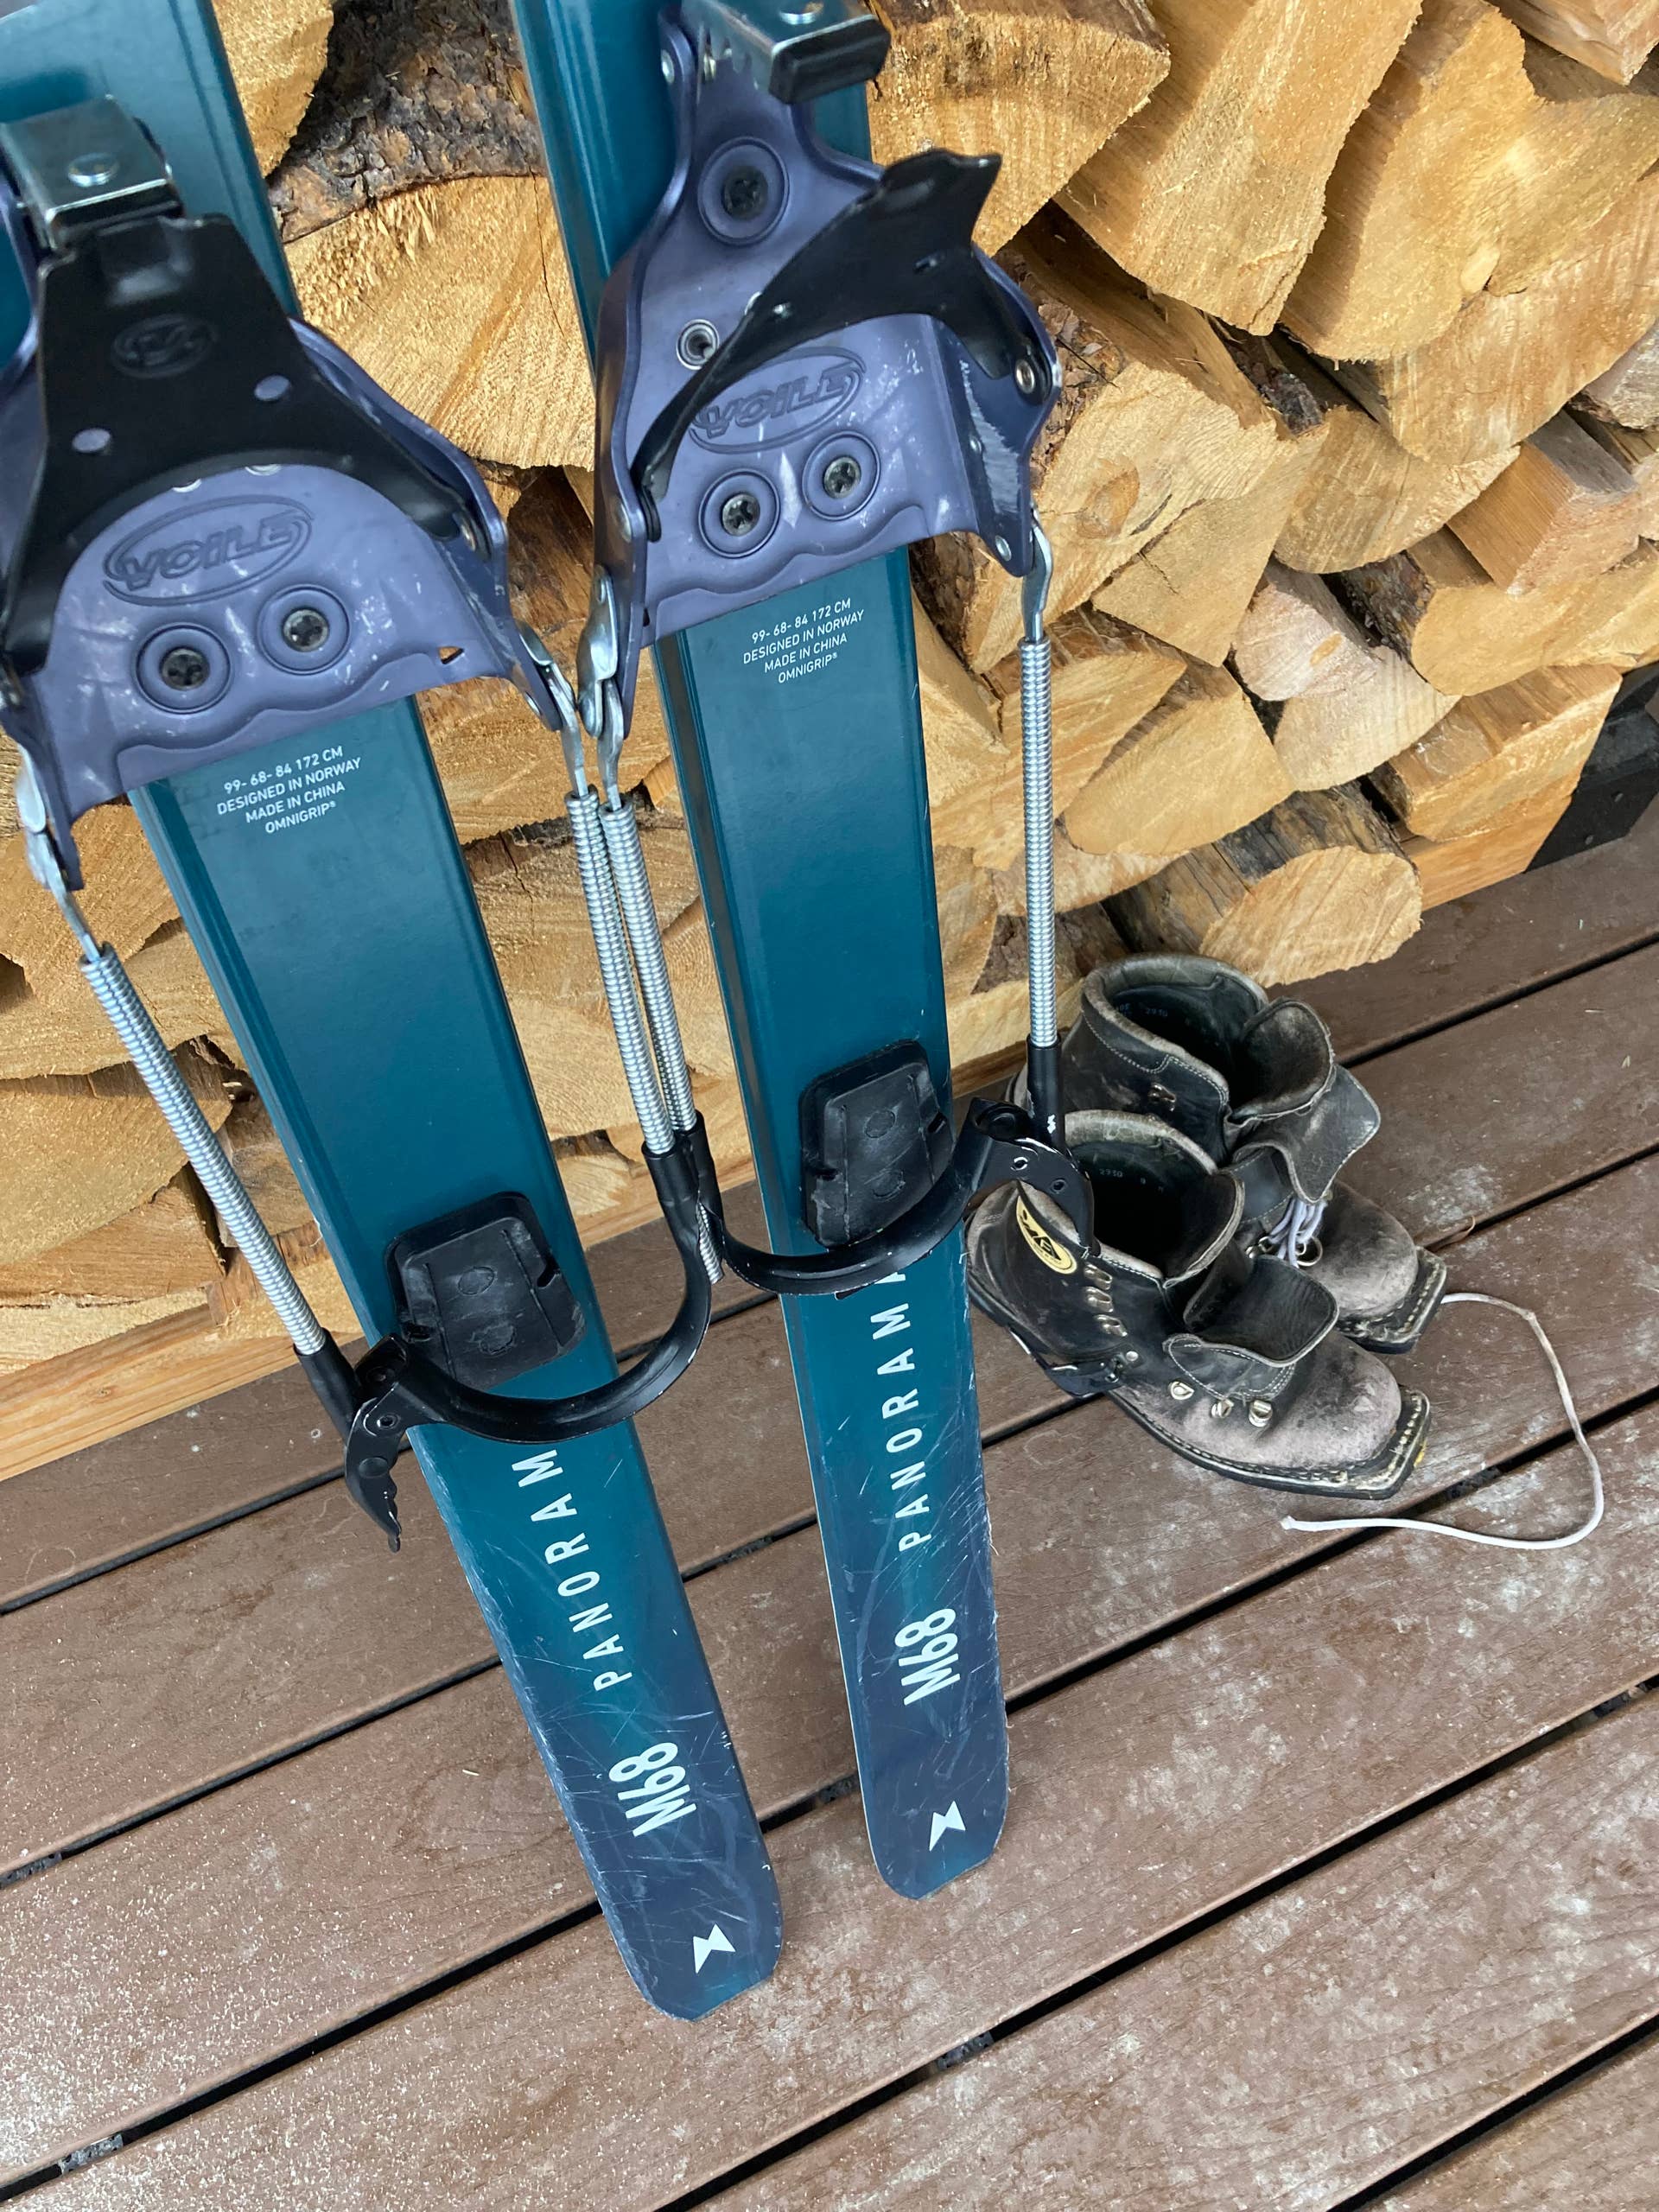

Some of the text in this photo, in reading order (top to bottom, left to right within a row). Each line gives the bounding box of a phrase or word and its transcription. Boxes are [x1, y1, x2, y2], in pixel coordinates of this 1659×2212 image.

[115, 509, 301, 592] VOILE
[743, 609, 865, 664] DESIGNED IN NORWAY
[752, 597, 851, 644] 99- 68- 84 172 CM
[765, 632, 848, 673] MADE IN CHINA
[217, 757, 361, 815] DESIGNED IN NORWAY
[224, 746, 343, 794] 99- 68- 84 172 CM
[245, 781, 346, 823] MADE IN CHINA
[512, 1449, 697, 1837] M68 PANORAM
[894, 1608, 961, 1706] M68
